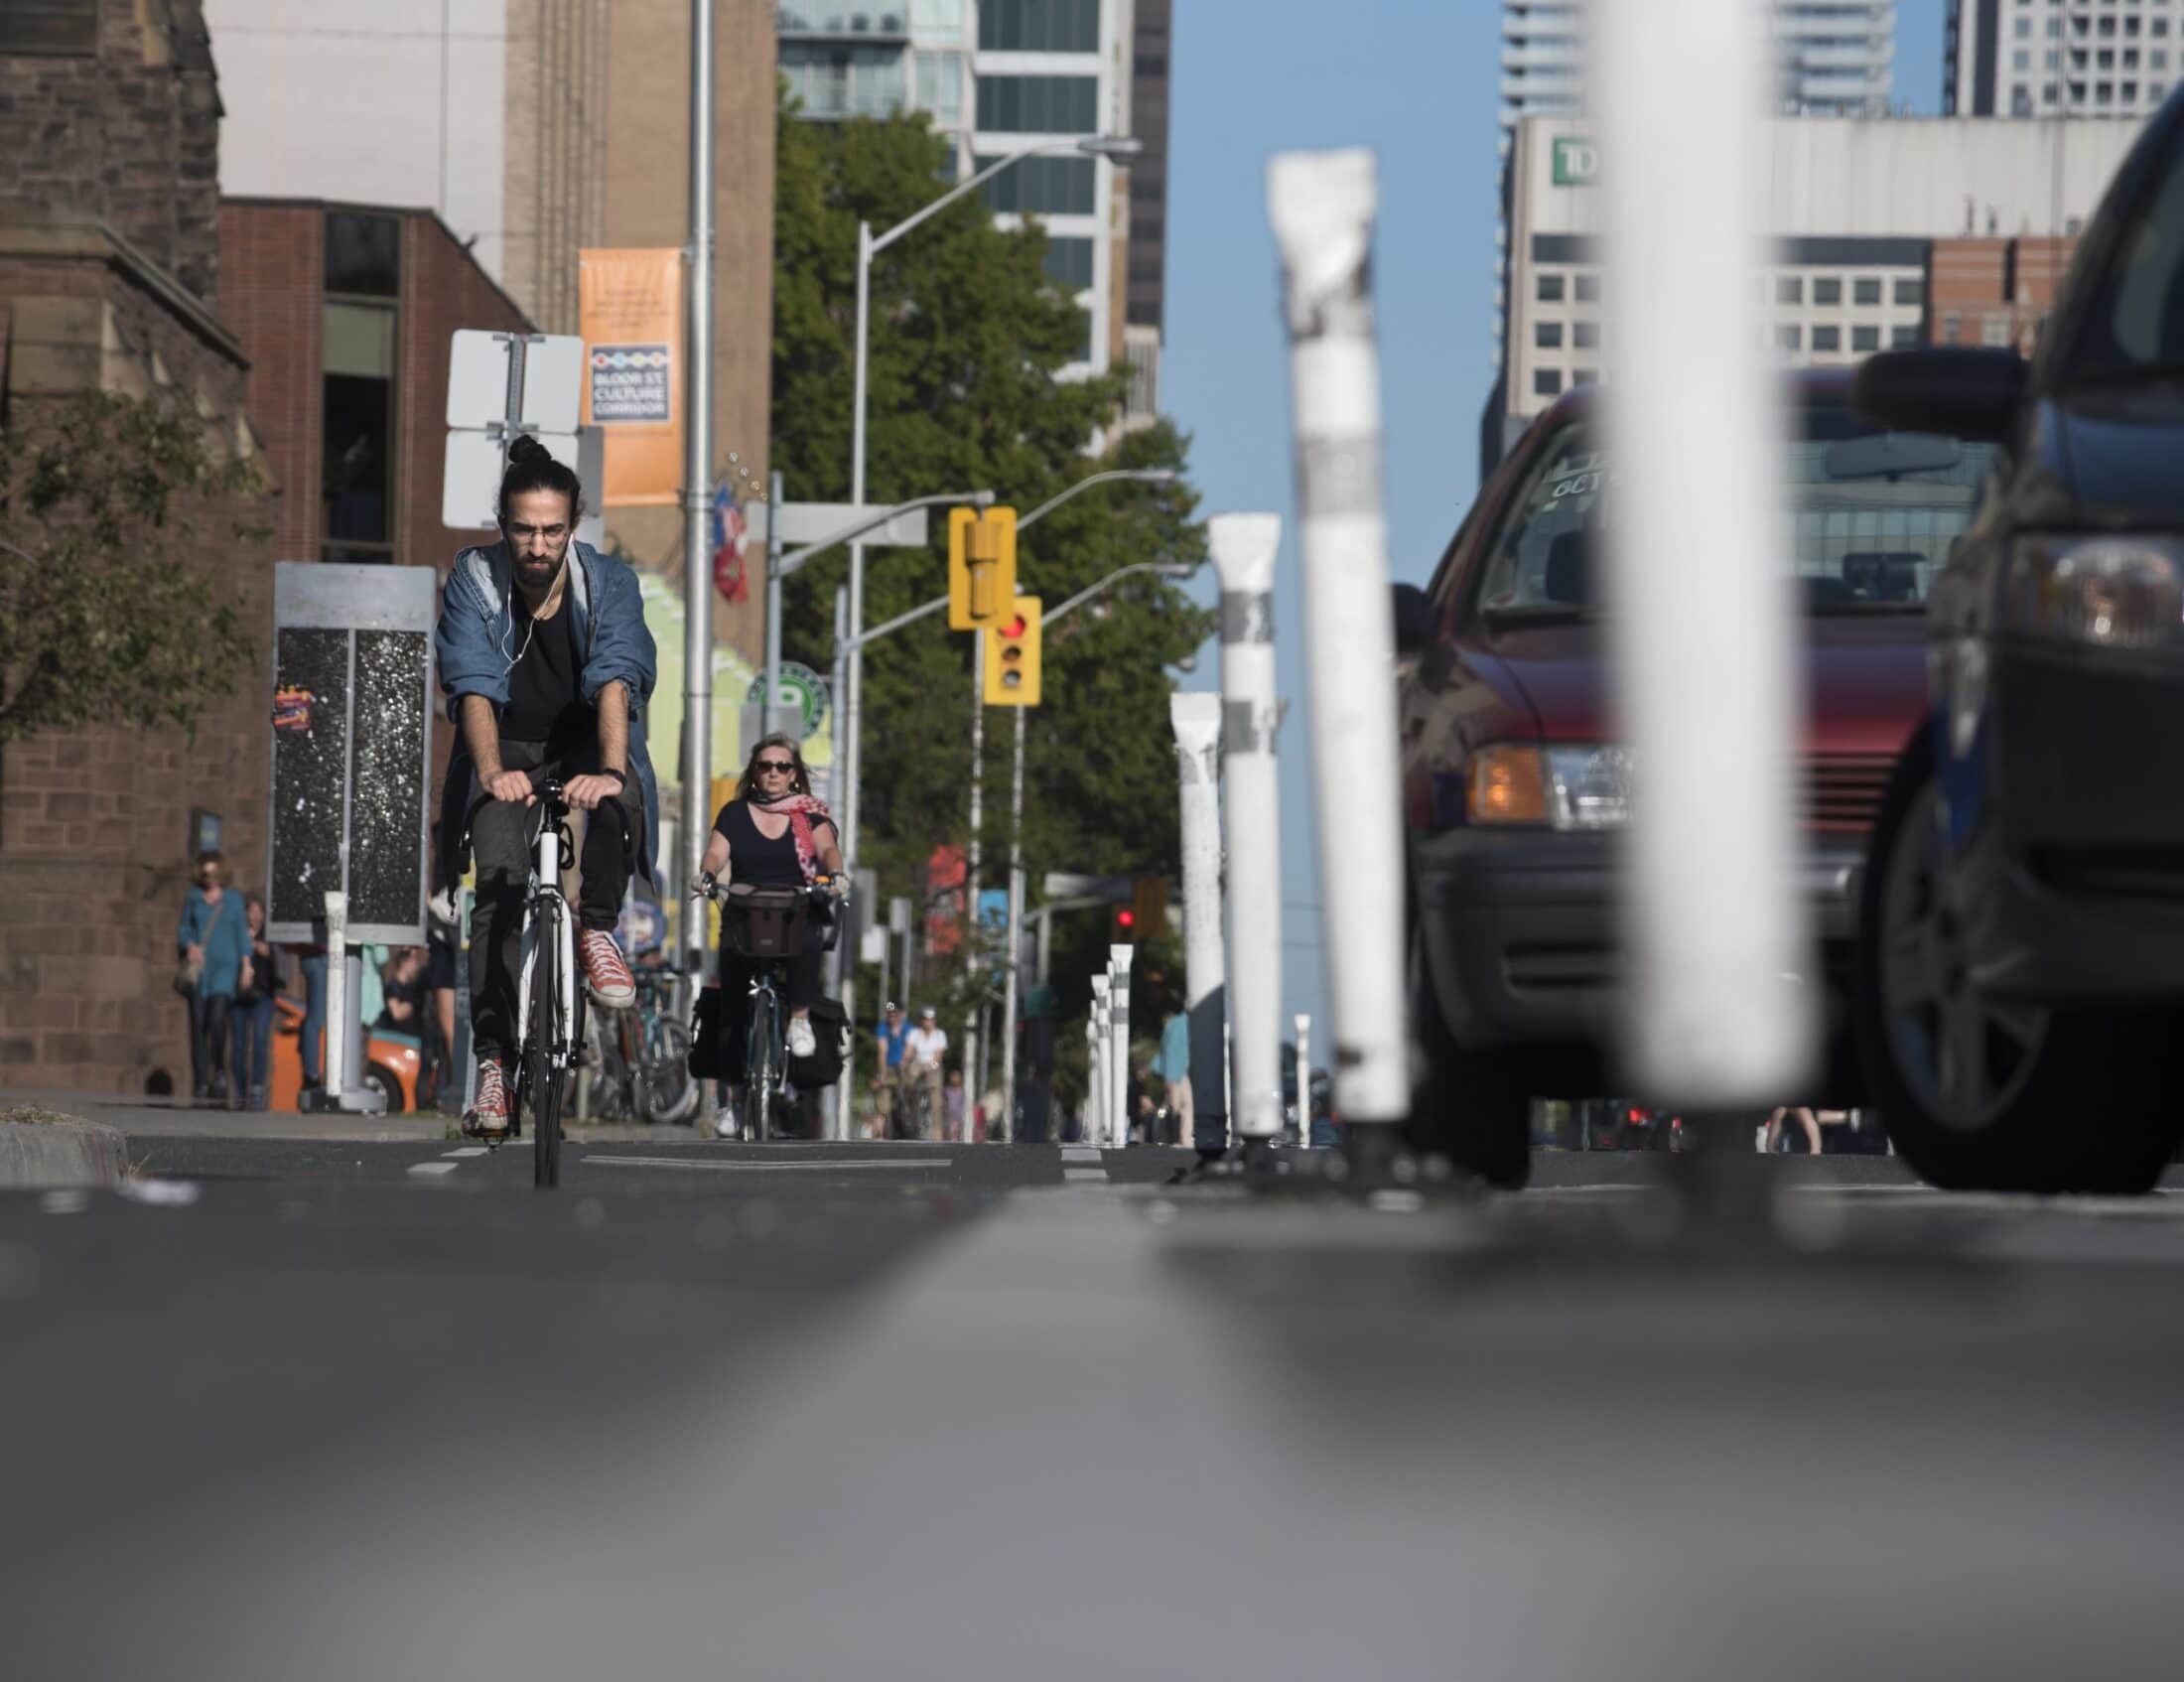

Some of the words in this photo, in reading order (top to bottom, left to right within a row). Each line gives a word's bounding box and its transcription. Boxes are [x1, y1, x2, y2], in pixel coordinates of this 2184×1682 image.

[1559, 143, 1597, 176] TD
[594, 372, 642, 386] BLOOR
[594, 386, 664, 401] CULTURE
[594, 402, 665, 415] CORRIDOR
